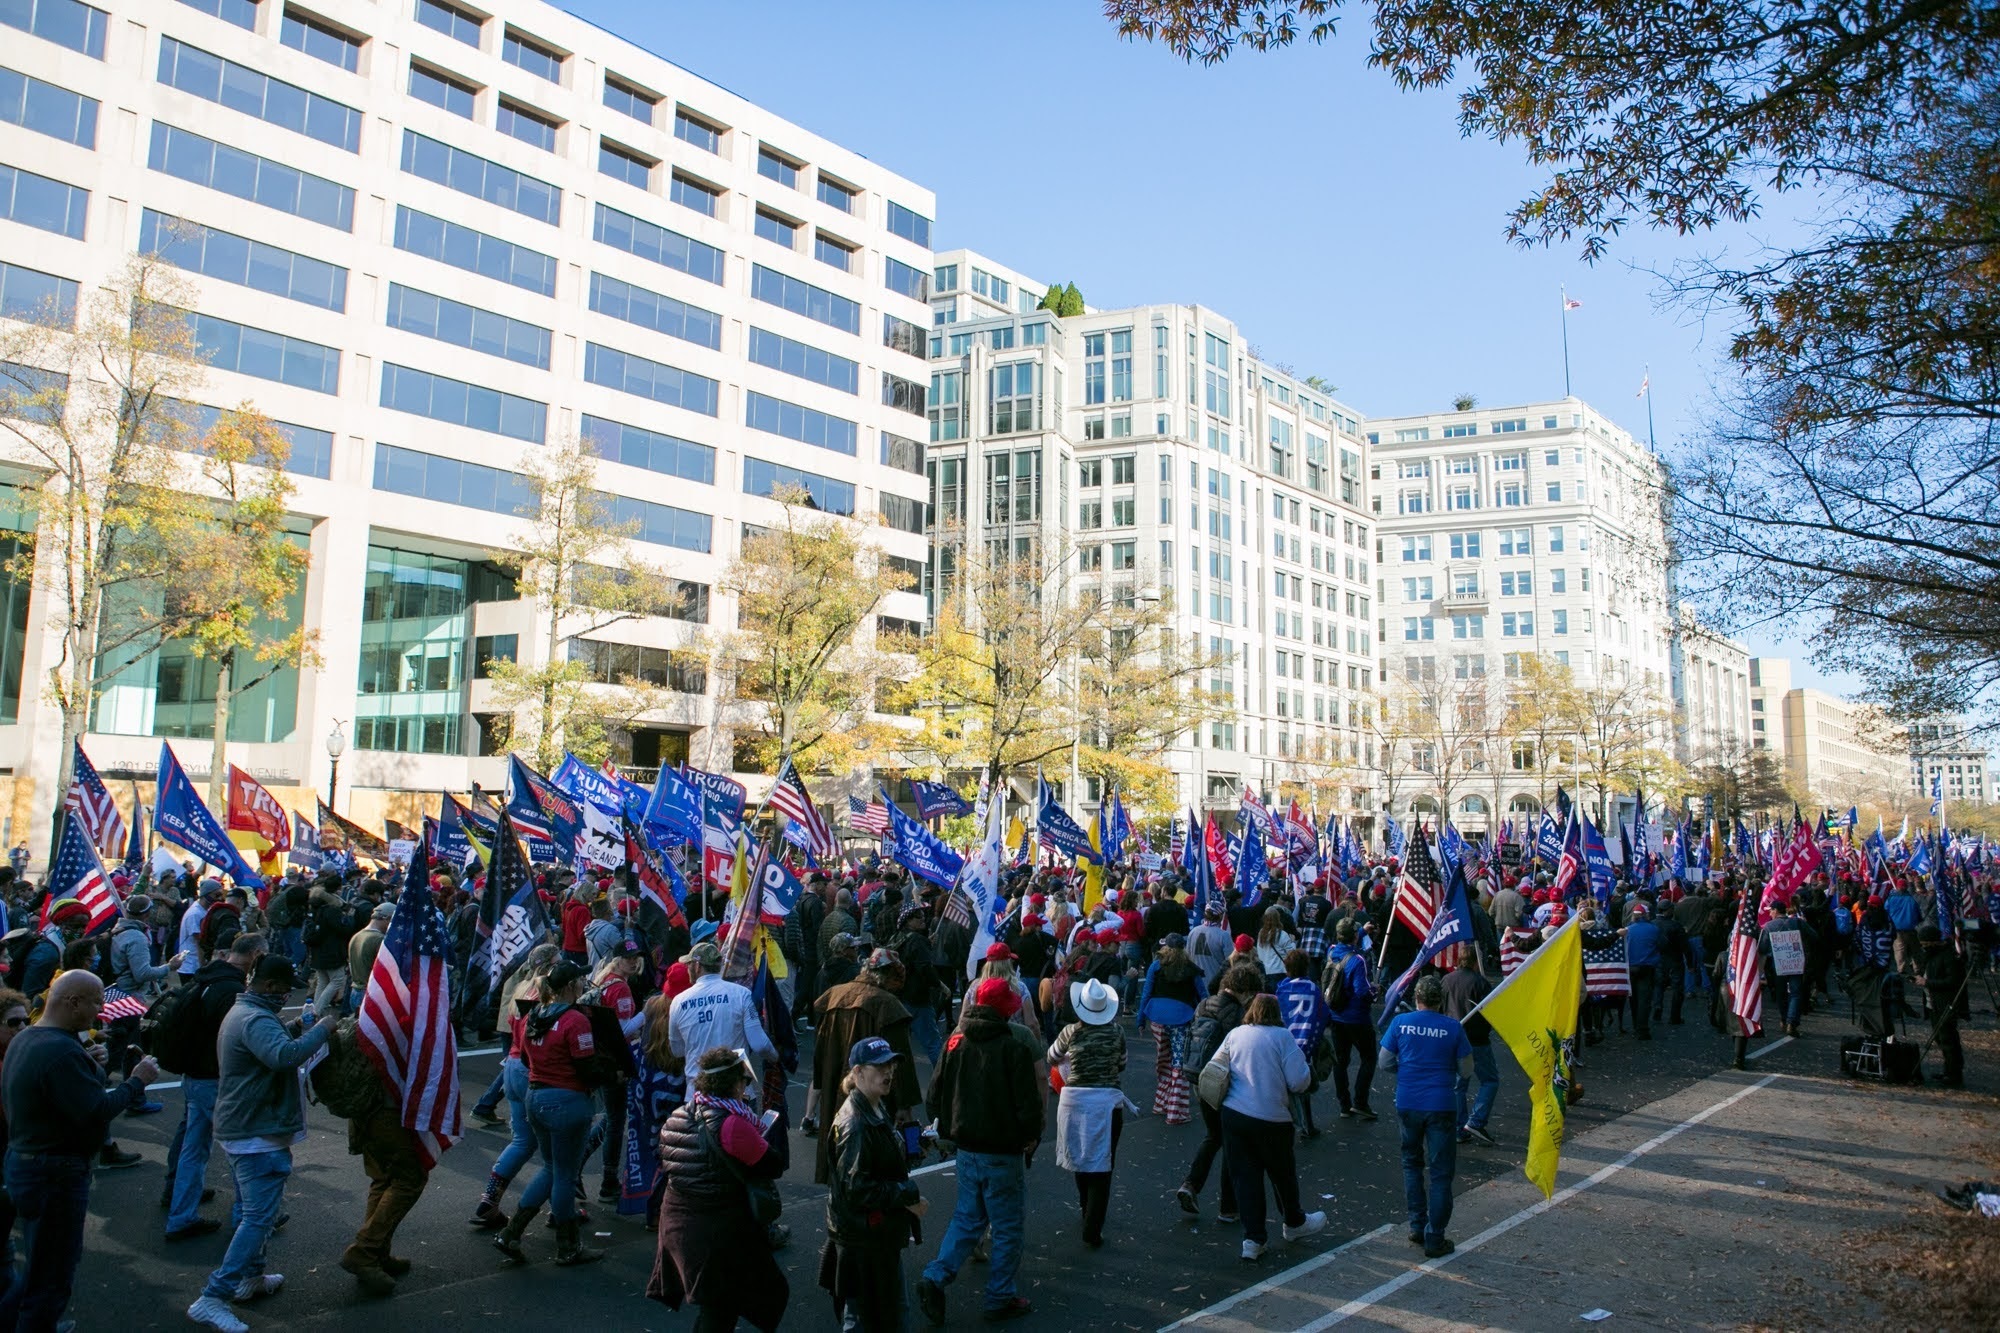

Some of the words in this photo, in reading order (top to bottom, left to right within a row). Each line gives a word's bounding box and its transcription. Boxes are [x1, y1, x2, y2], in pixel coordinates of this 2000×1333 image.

[637, 770, 647, 782] &
[686, 769, 740, 797] TRUMP
[163, 812, 187, 829] KEEP
[686, 810, 703, 831] 202
[1050, 826, 1080, 844] AMERICA
[531, 843, 554, 851] TRUMP
[599, 851, 618, 867] AND
[1588, 856, 1603, 865] NO
[916, 858, 956, 882] FEELINGS
[698, 1010, 713, 1023] 20
[1399, 1024, 1449, 1039] TRUMP
[629, 1126, 643, 1188] GREAT!
